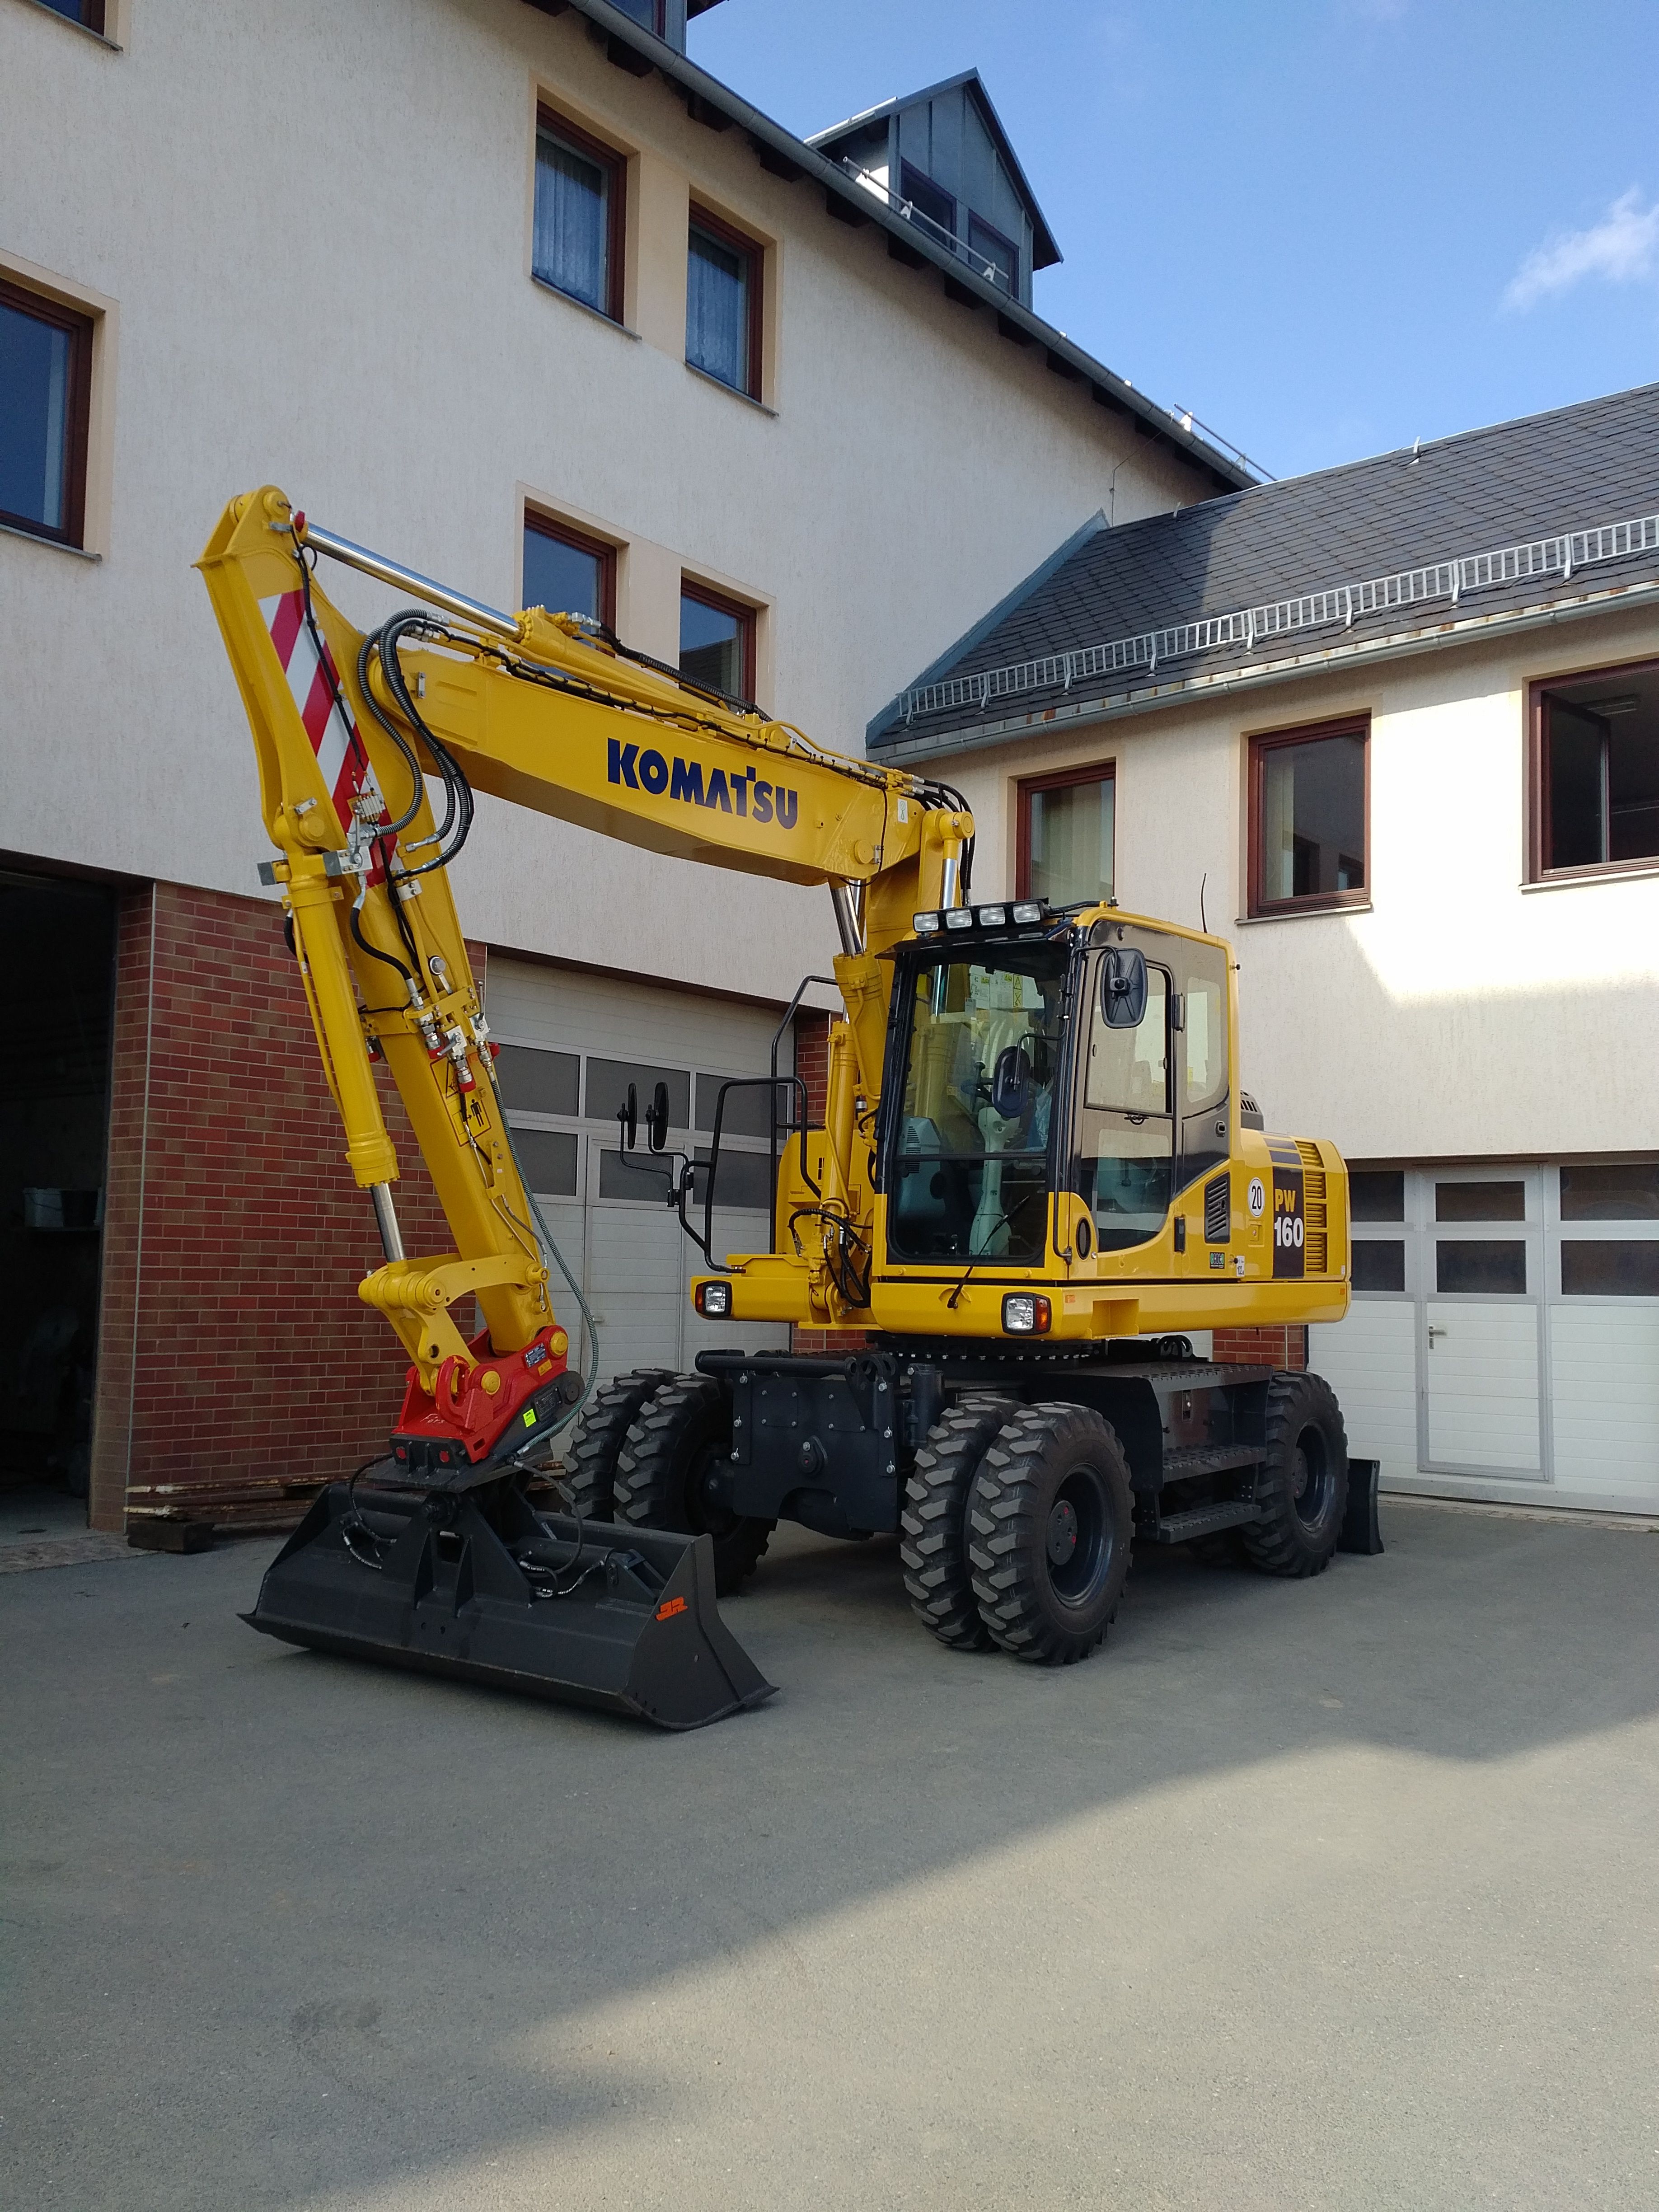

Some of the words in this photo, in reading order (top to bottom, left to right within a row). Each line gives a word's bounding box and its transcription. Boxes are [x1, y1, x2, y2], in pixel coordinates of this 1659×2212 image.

[608, 737, 798, 830] KOMATSU
[1251, 1186, 1262, 1209] 20
[1275, 1189, 1296, 1212] PW
[1274, 1217, 1304, 1247] 160
